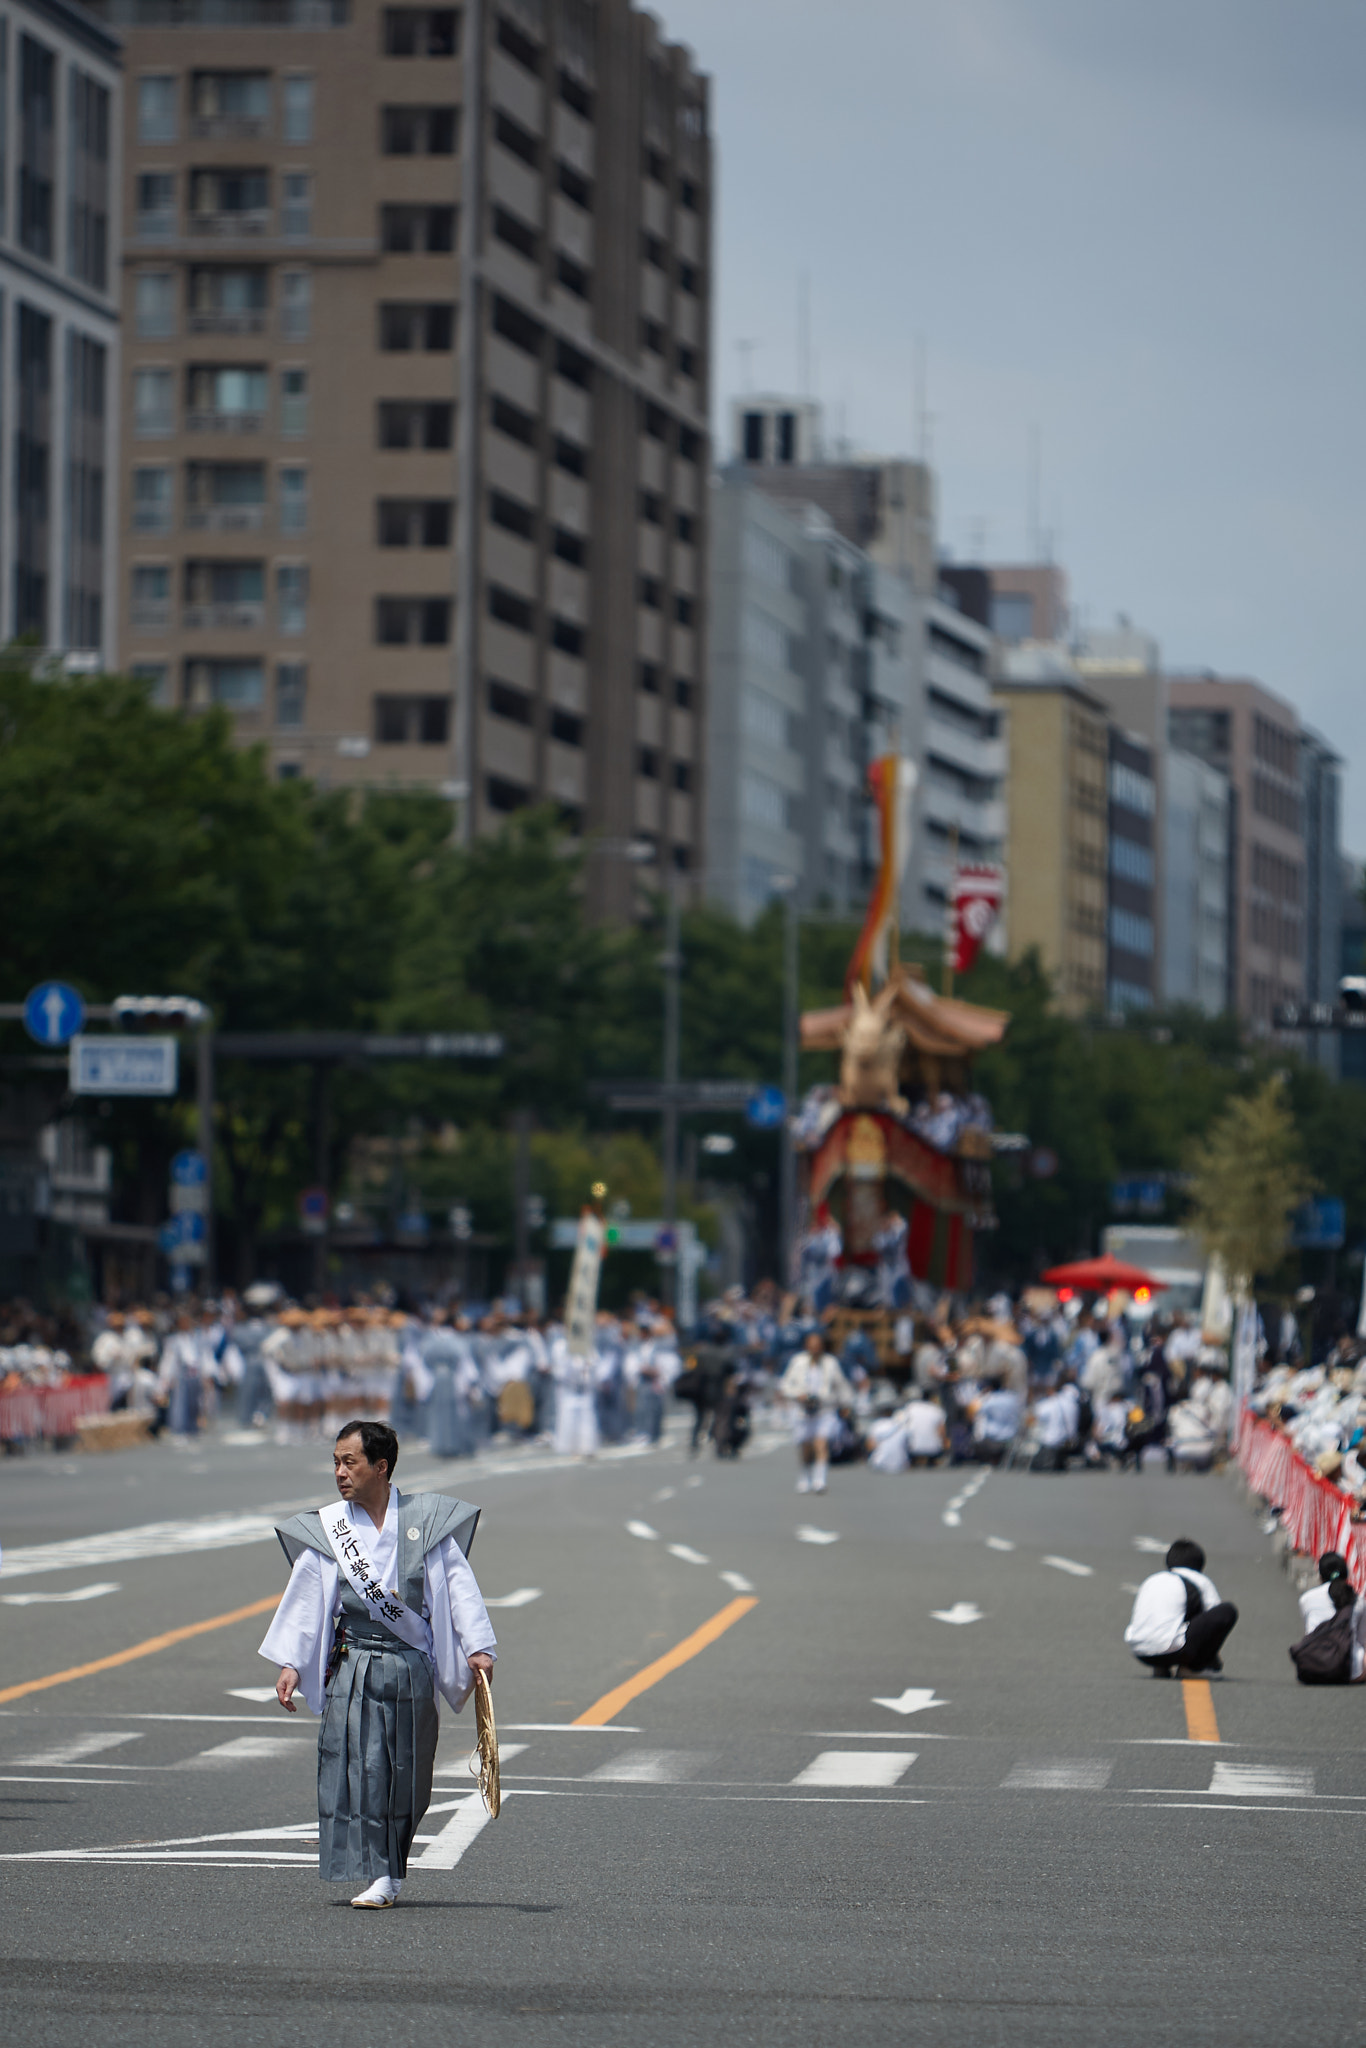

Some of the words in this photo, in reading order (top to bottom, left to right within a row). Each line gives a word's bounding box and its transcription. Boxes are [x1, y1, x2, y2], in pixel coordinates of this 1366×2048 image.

[332, 1518, 404, 1622] 巡行警備係
